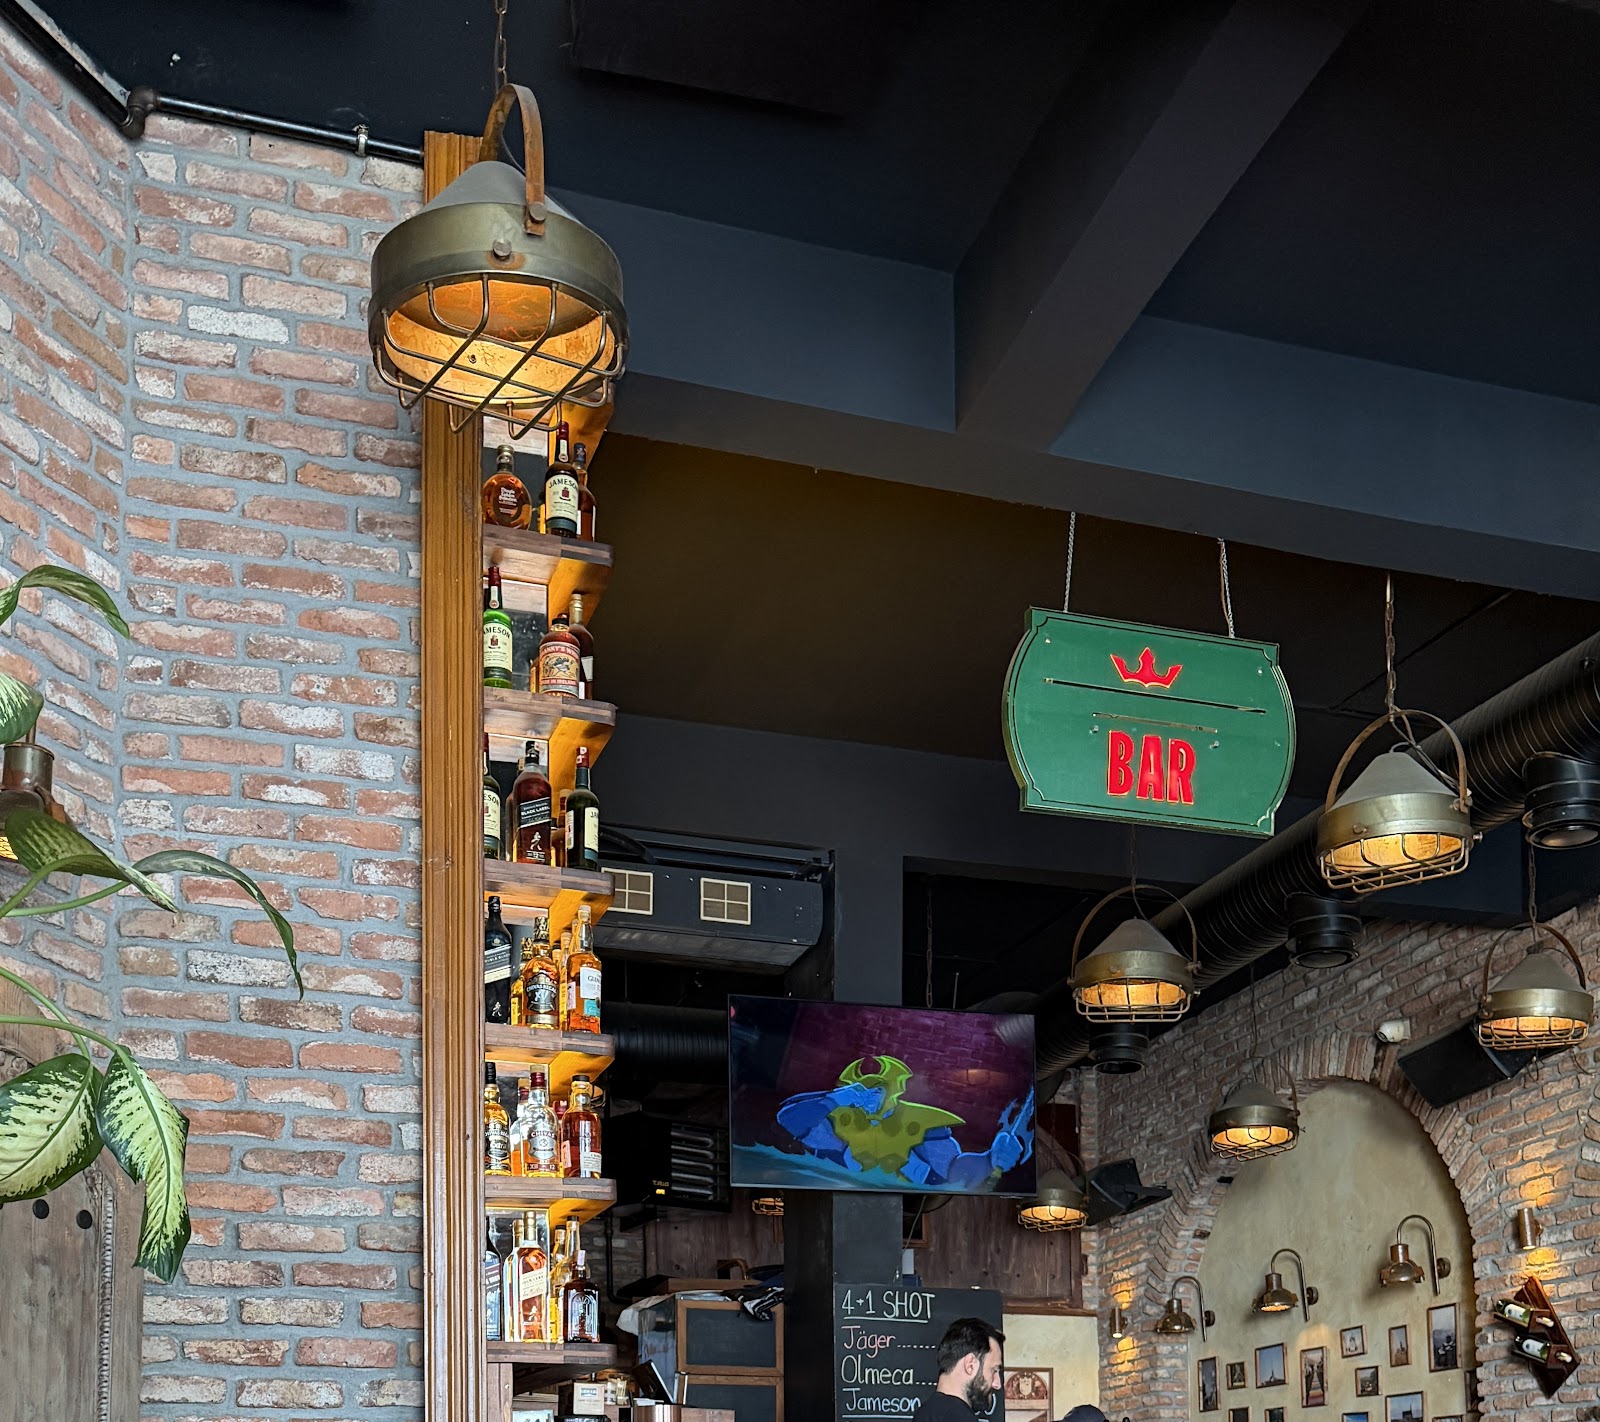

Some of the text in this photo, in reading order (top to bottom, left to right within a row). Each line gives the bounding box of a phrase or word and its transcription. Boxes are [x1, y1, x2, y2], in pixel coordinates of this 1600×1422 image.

[1107, 729, 1196, 805] BAR
[531, 1130, 555, 1138] CHIVAS
[841, 1289, 936, 1319] 4+1 SHOT
